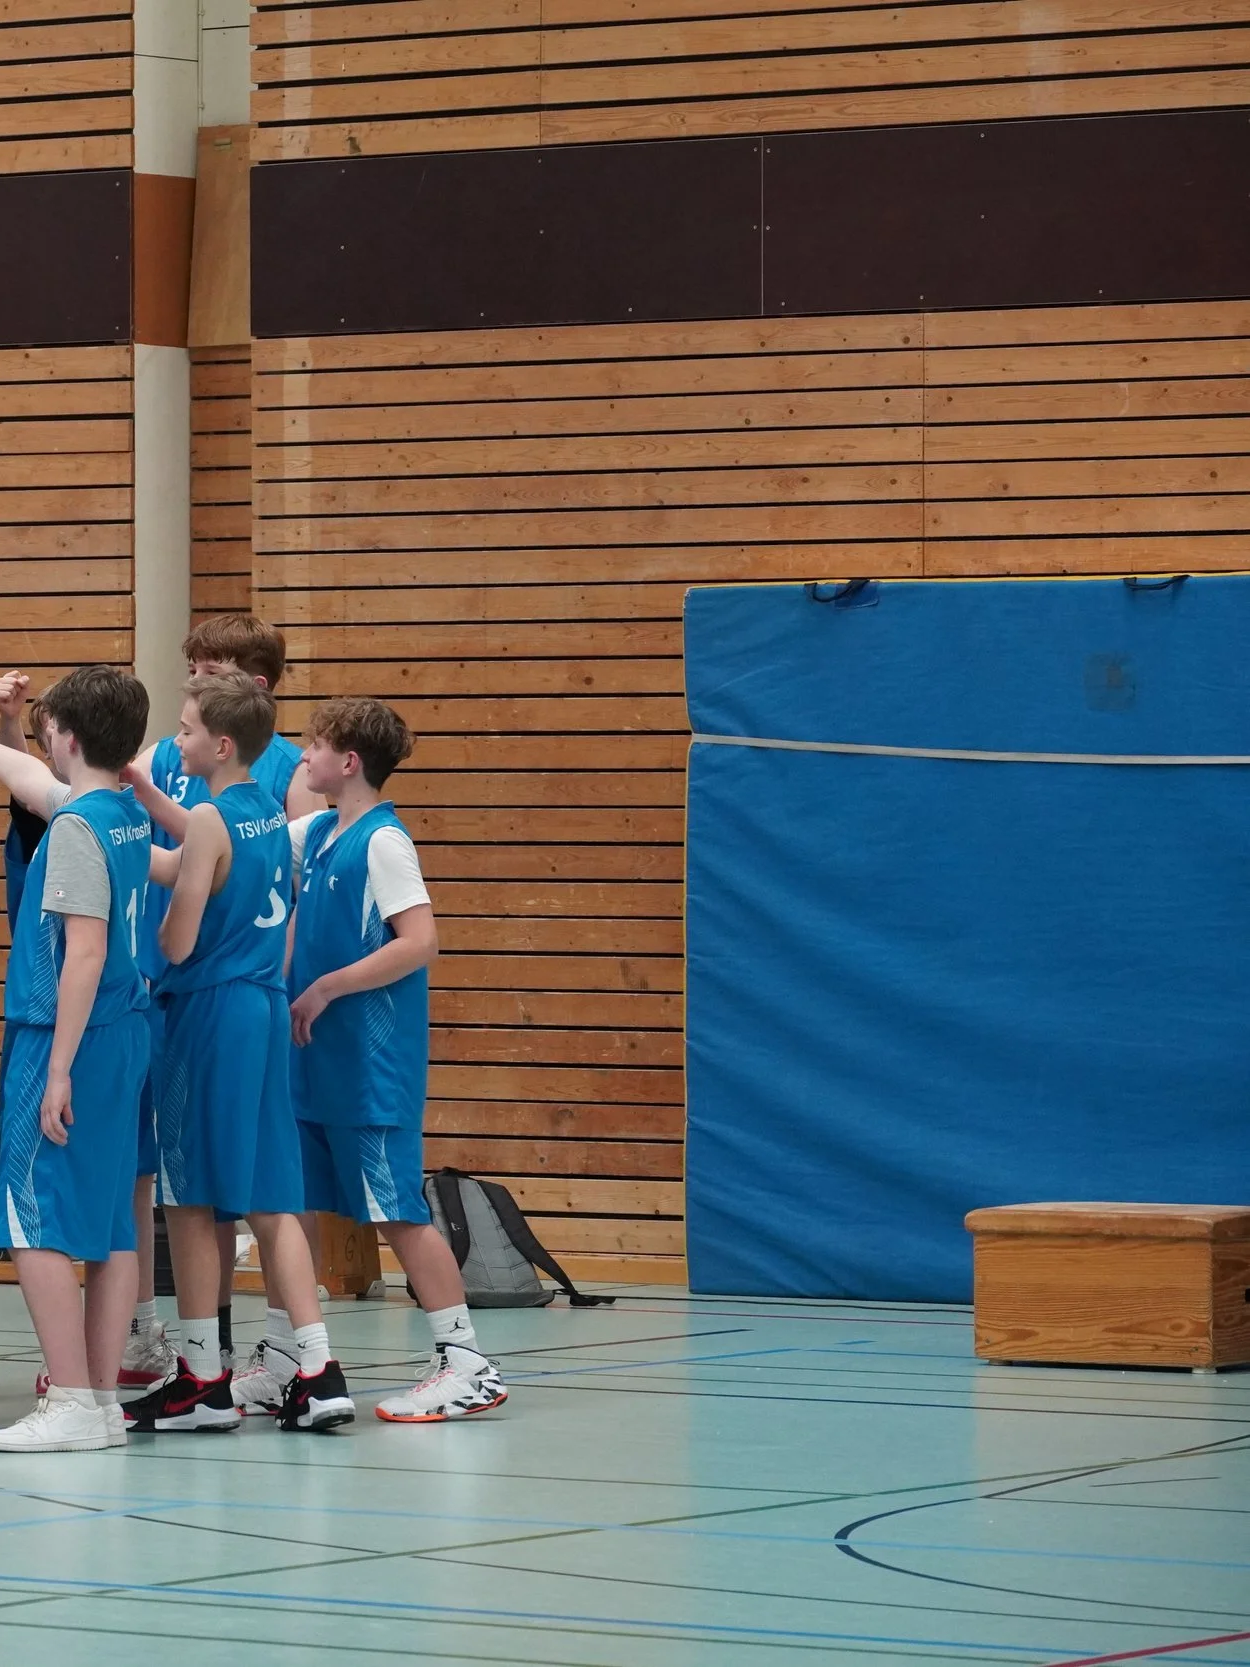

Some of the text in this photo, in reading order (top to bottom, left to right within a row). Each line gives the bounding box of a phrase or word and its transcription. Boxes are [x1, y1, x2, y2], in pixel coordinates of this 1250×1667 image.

[166, 772, 190, 803] 13
[109, 826, 127, 846] TSV
[235, 819, 261, 840] TSV
